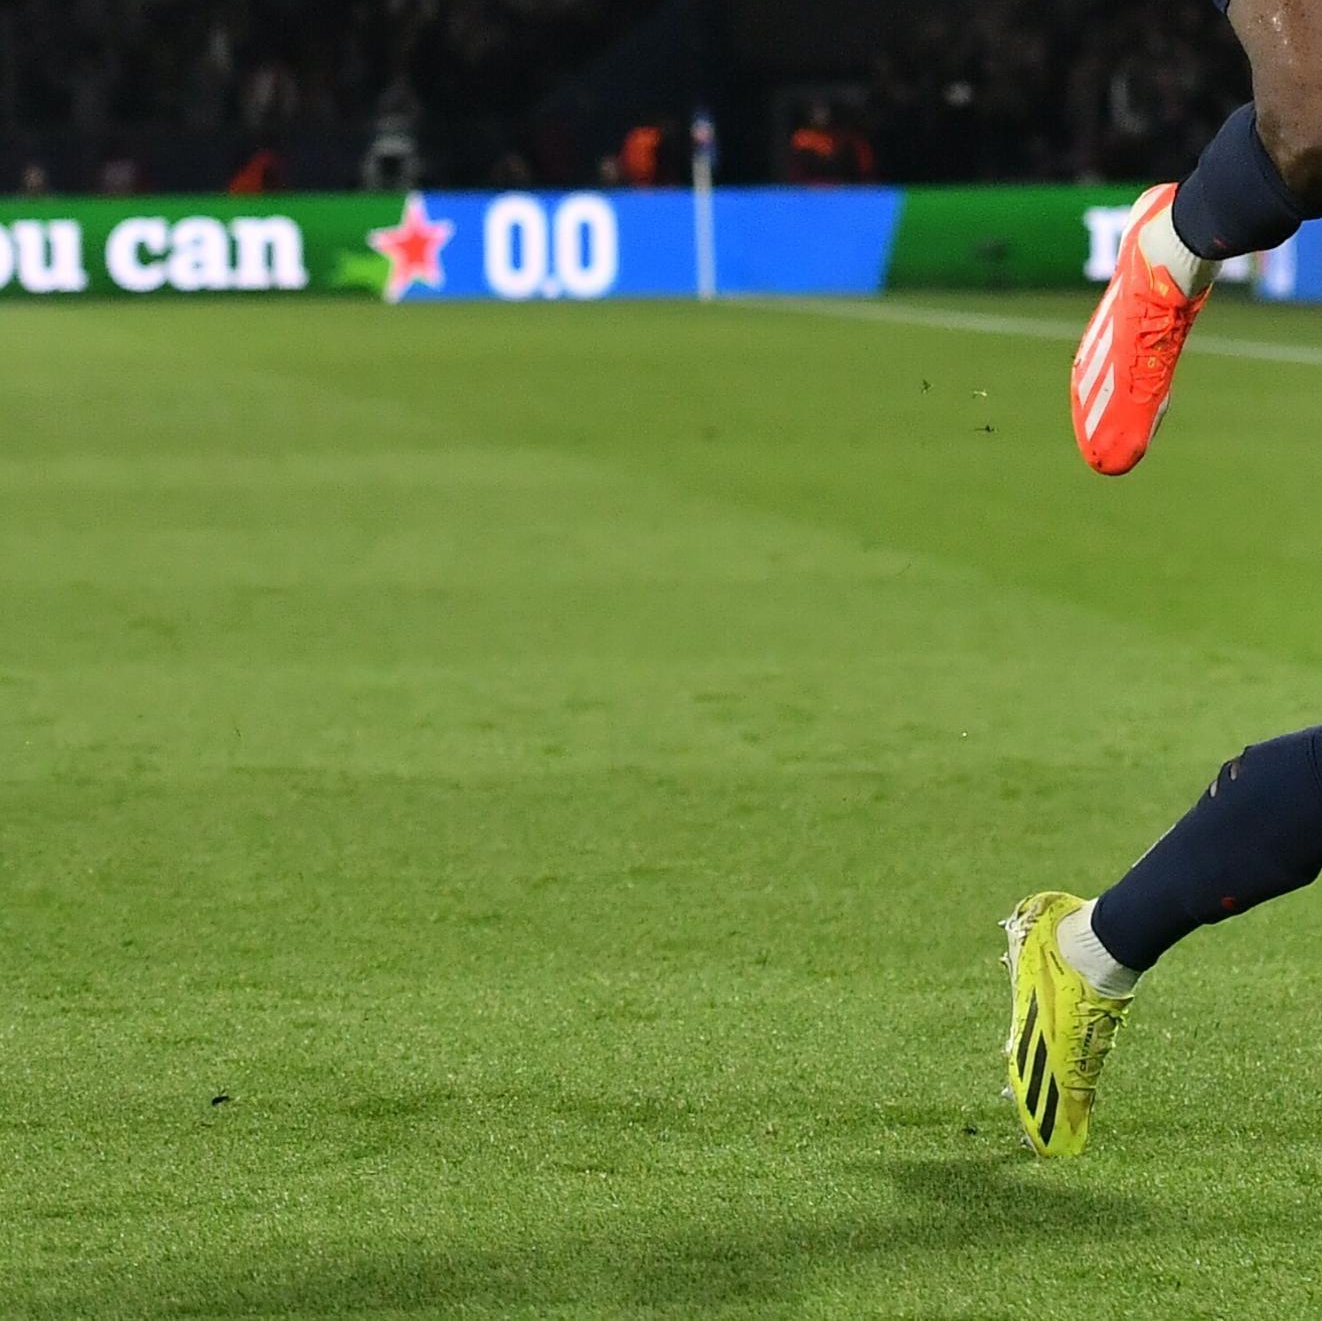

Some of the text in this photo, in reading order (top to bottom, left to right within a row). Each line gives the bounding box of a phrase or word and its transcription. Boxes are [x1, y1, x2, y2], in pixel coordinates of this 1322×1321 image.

[0, 215, 309, 293] u can
[485, 191, 619, 300] 0.0
